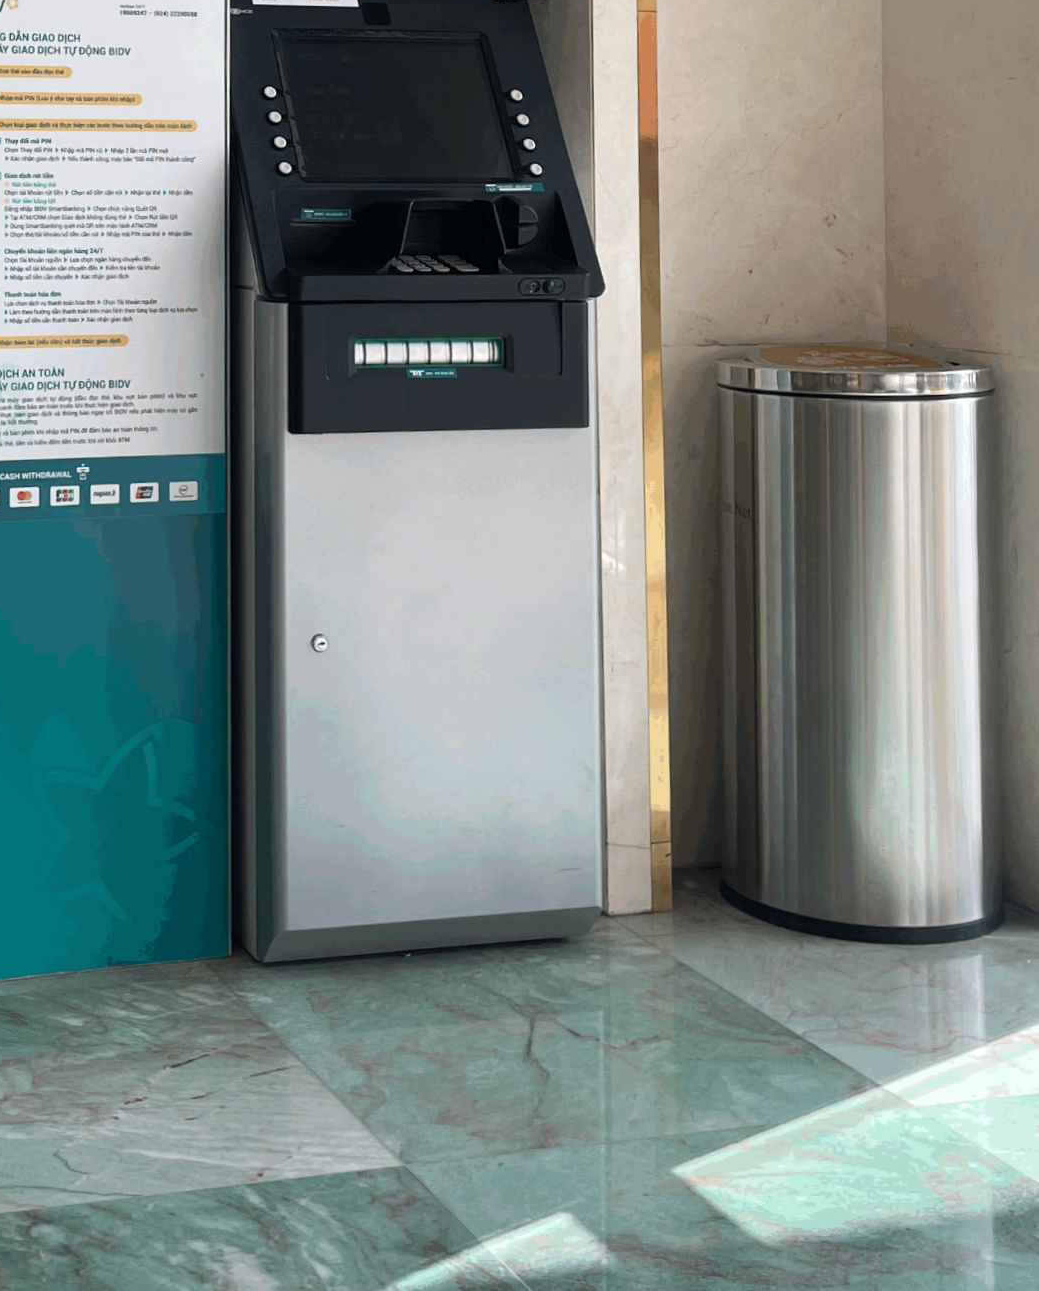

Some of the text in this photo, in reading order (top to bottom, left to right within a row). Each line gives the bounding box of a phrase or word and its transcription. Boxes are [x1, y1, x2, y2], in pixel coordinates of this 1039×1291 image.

[9, 30, 29, 42] DẪN
[32, 33, 55, 42] GIAO
[58, 34, 80, 44] DỊCH
[12, 45, 35, 54] GIAO
[37, 46, 60, 56] DỊCH
[63, 46, 76, 56] TỰ
[79, 45, 105, 57] ĐỘNG
[109, 47, 131, 56] BIDV
[22, 369, 35, 378] AN
[39, 367, 64, 378] TOÀN
[11, 381, 34, 391] GIAO
[37, 381, 60, 391] DỊCH
[63, 380, 76, 391] TỰ
[79, 378, 106, 390] ĐỘNG
[108, 380, 131, 389] BIDV
[0, 472, 20, 480] CASH
[22, 470, 71, 479] WITHDRAWAL
